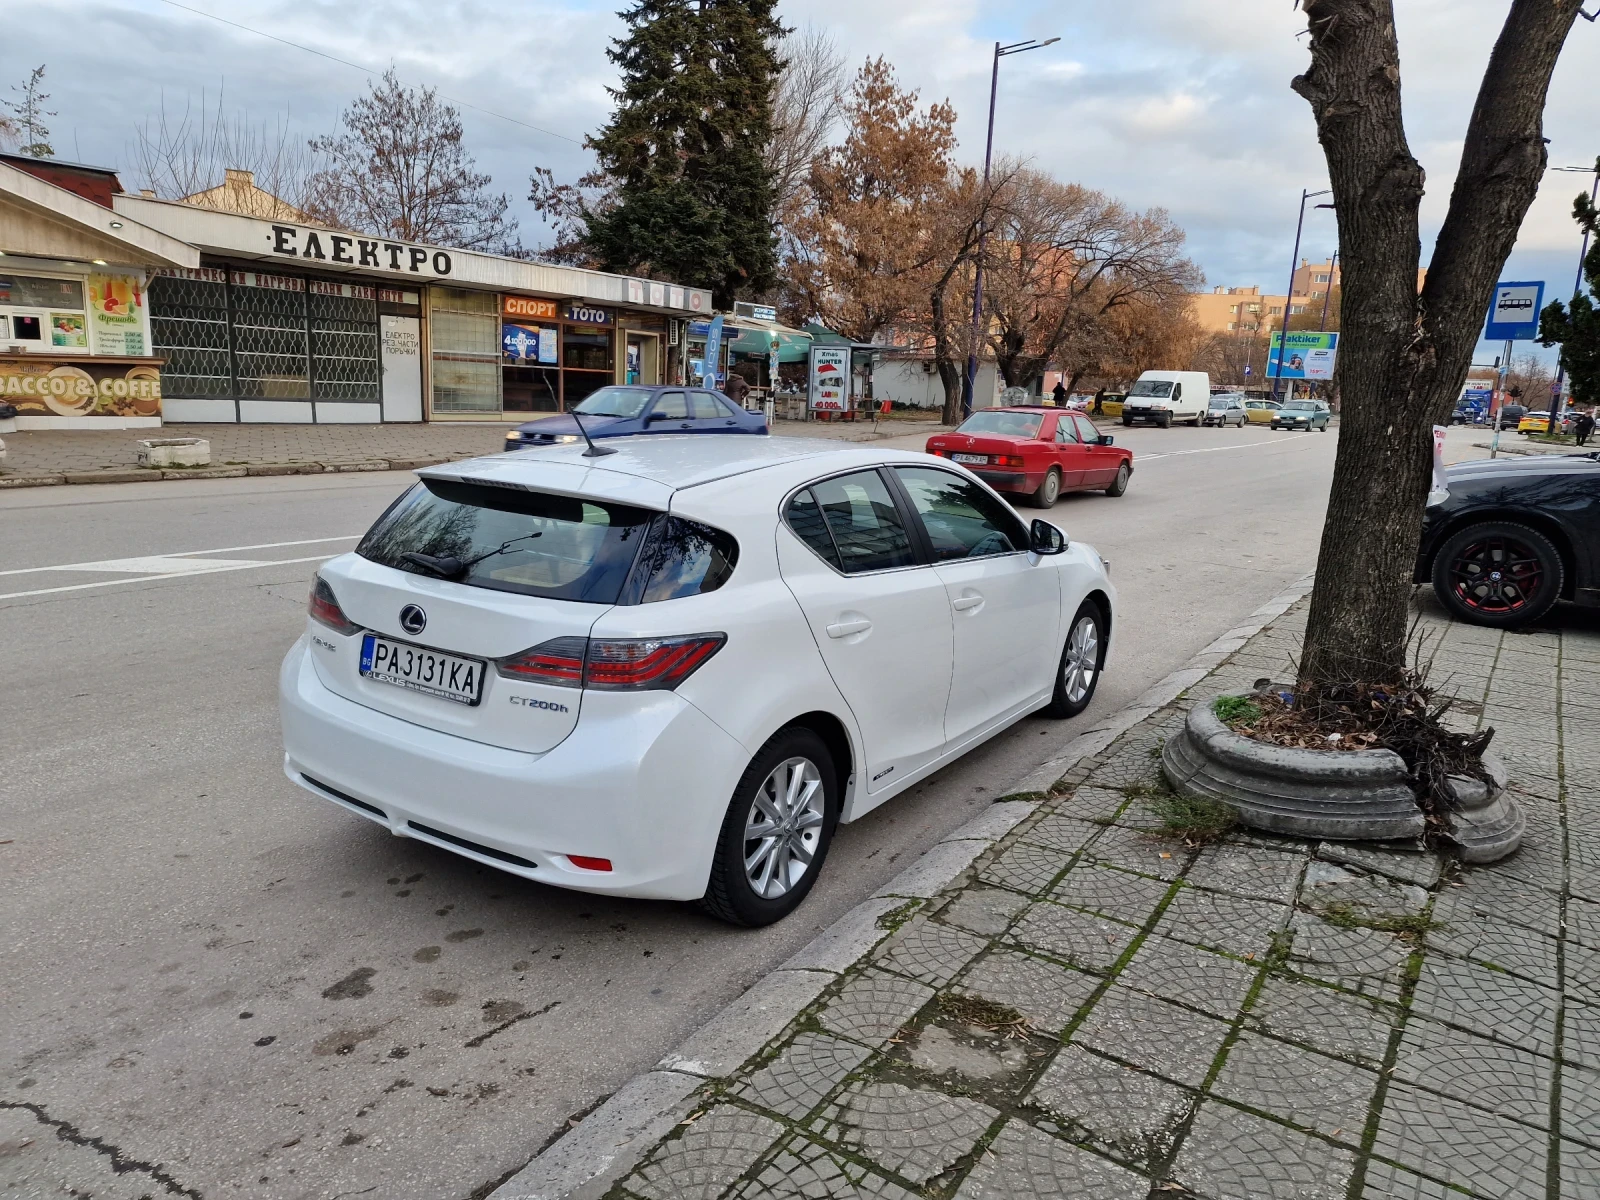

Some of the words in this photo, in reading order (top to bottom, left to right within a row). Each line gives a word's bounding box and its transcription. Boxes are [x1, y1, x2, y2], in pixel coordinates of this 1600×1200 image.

[272, 225, 452, 275] ЕЛЕКТРО
[506, 299, 555, 316] СПОРТ
[385, 331, 416, 340] ЕЛЕКТРО
[1275, 335, 1321, 344] Paktiker
[398, 340, 419, 348] ЧАСТИ
[385, 347, 416, 355] ПОРЪЧКИ
[75, 378, 92, 395] &
[362, 657, 371, 666] BG
[373, 672, 406, 687] LEXUS
